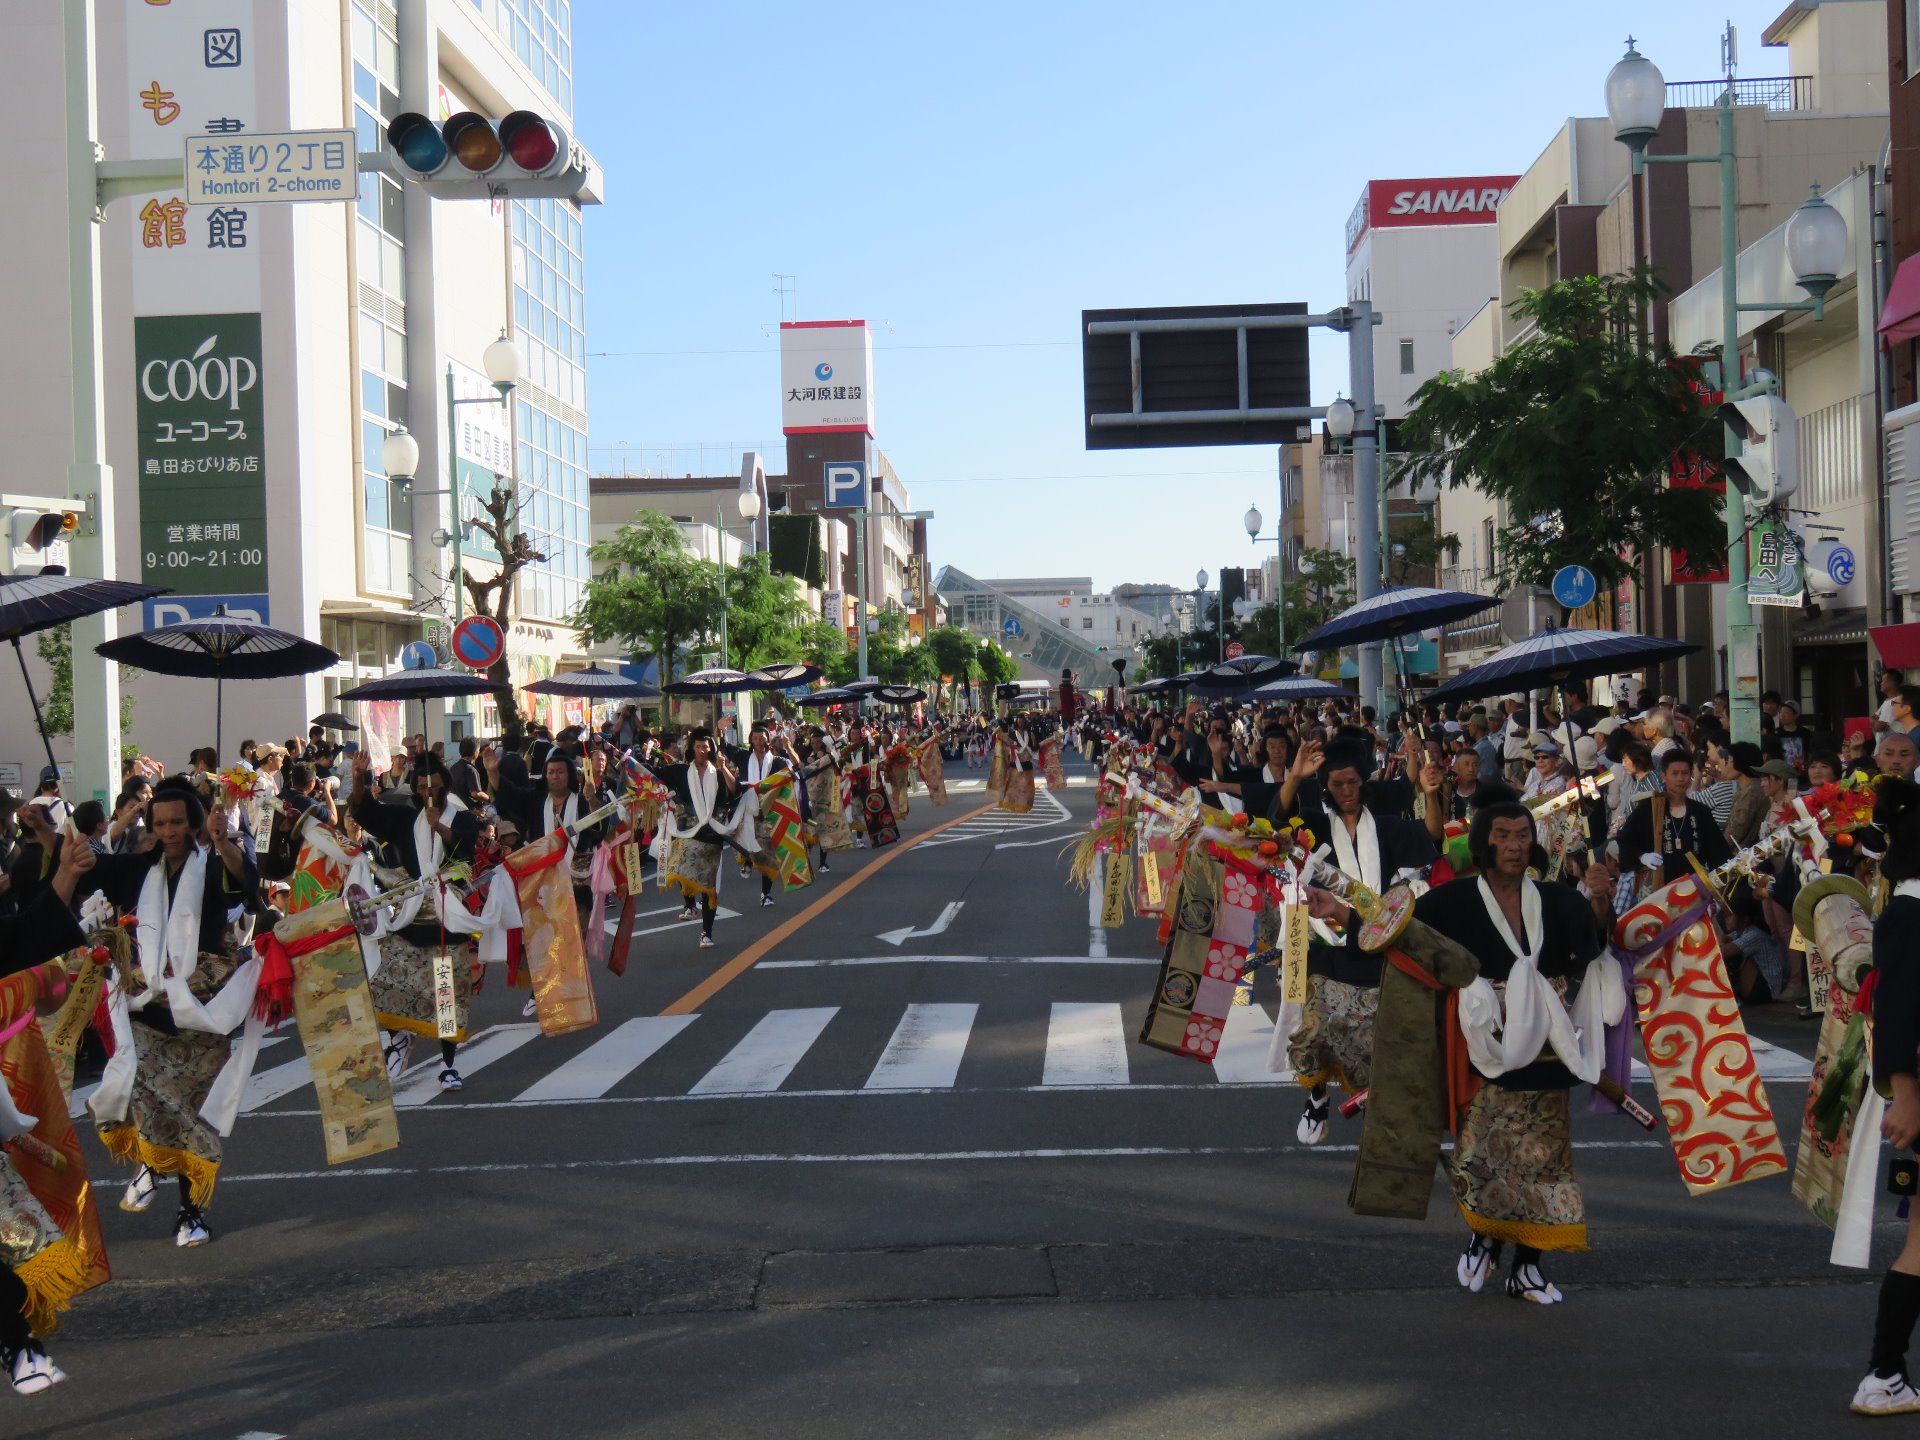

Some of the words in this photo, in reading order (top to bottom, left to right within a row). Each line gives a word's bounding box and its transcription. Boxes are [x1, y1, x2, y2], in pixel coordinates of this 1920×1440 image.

[197, 142, 344, 175] 本通り2丁目
[202, 178, 260, 195] Hontori
[268, 177, 341, 194] 2-chome
[787, 386, 862, 402] 大河原建設
[156, 420, 247, 442] ユーコープ
[145, 456, 259, 475] 島田おびりあ店
[829, 467, 861, 503] P
[167, 523, 240, 543] 営業時間
[436, 964, 455, 1034] 安産祈願
